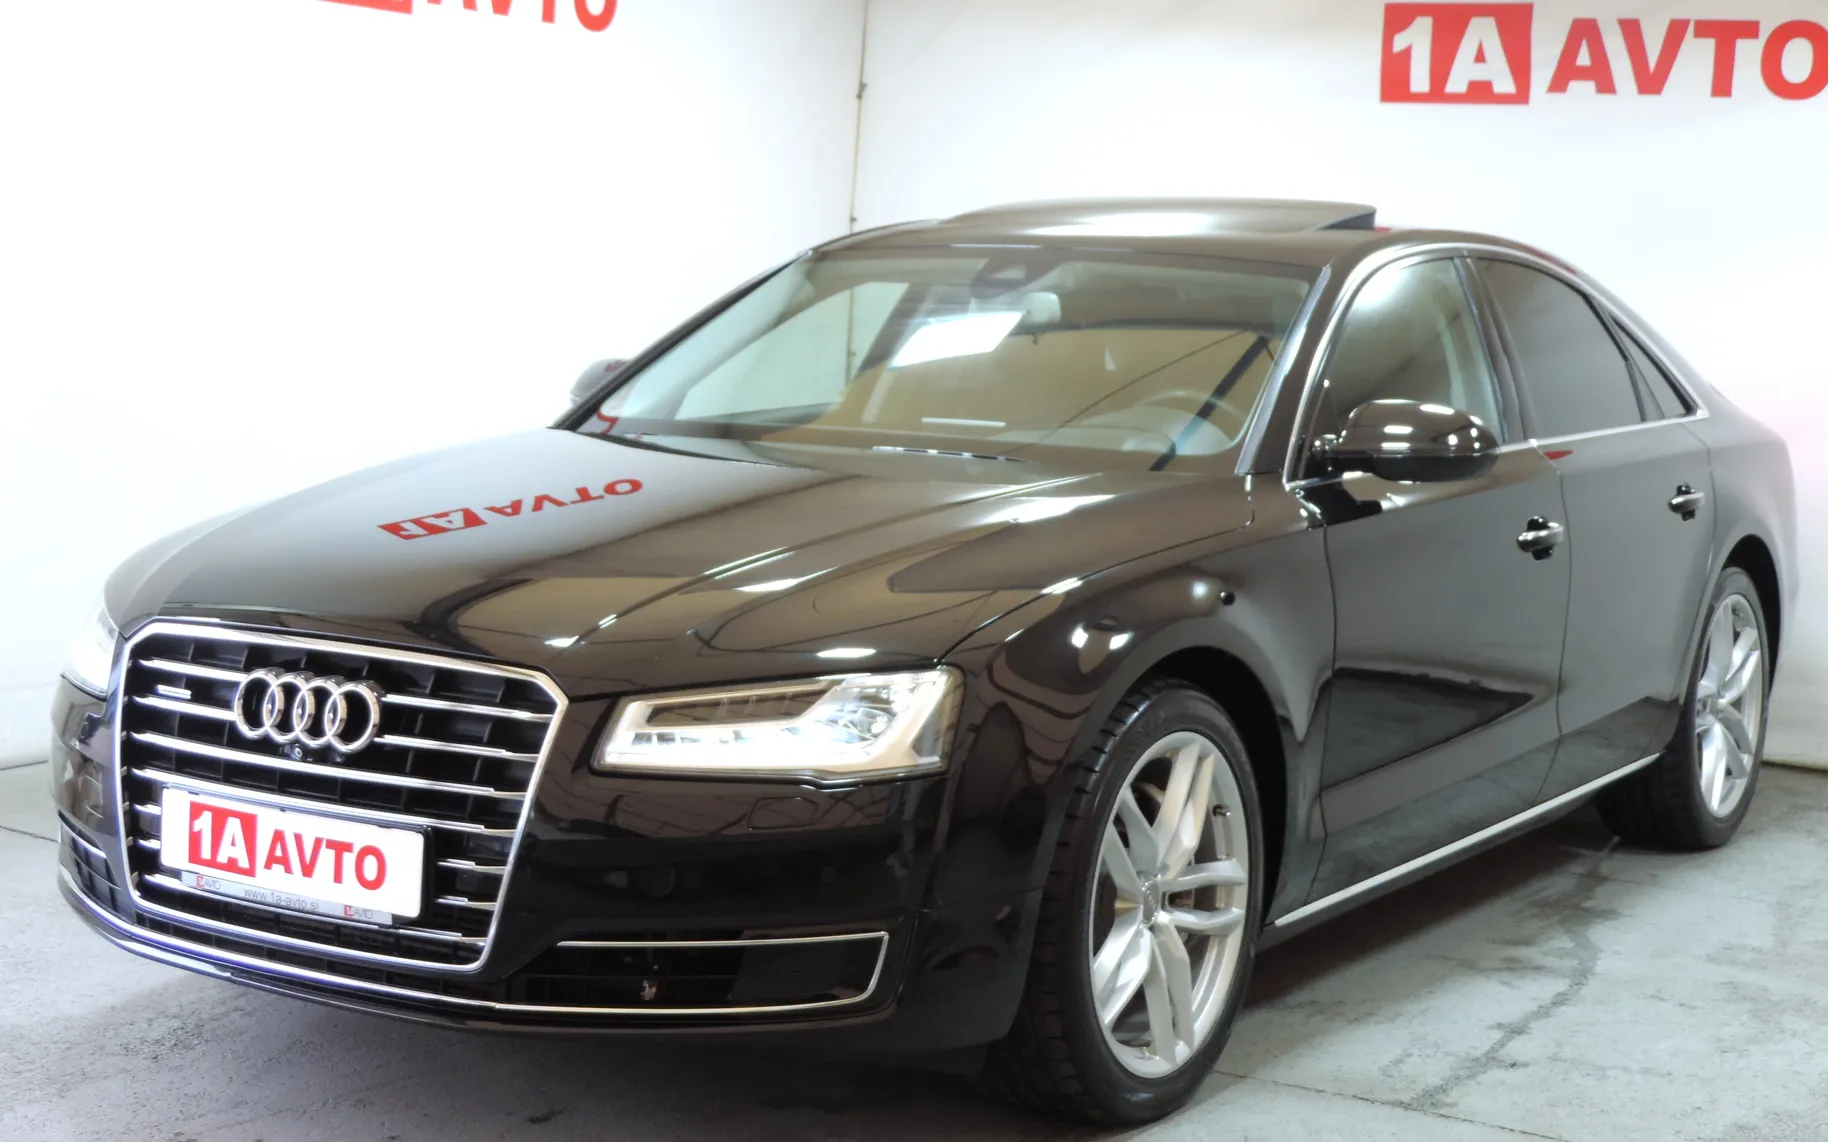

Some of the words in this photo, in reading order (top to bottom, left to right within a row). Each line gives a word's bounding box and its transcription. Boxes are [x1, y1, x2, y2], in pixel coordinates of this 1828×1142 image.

[1392, 16, 1517, 94] 1A
[1546, 18, 1828, 100] AVTO
[192, 809, 251, 869] 1A
[263, 829, 387, 891] AVTO
